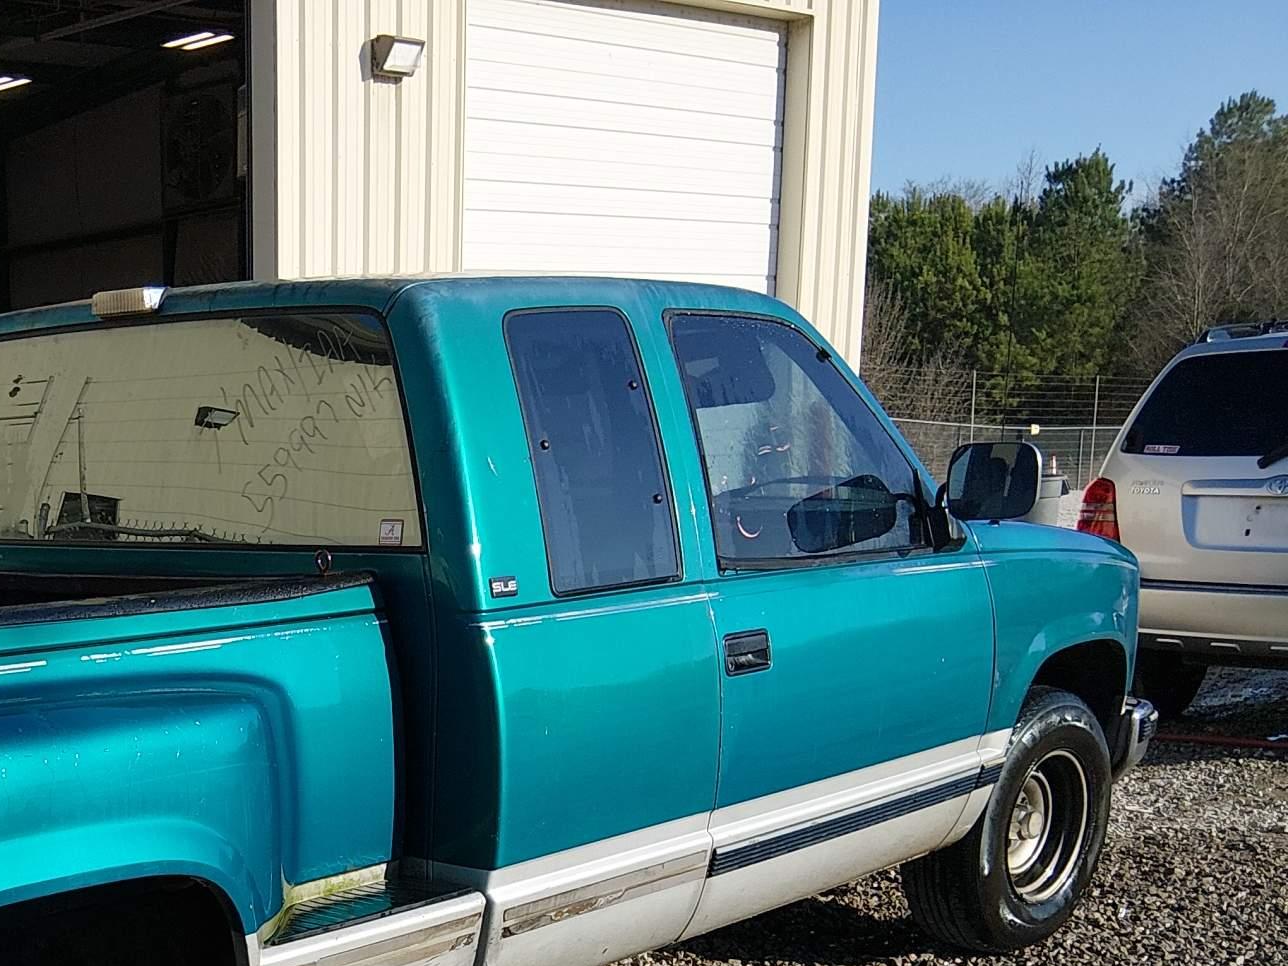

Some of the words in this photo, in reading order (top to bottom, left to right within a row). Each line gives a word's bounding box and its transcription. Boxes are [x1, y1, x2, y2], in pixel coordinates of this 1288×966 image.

[241, 400, 339, 533] 559997
[1131, 487, 1160, 495] TOYOTA
[492, 580, 517, 593] SLE
